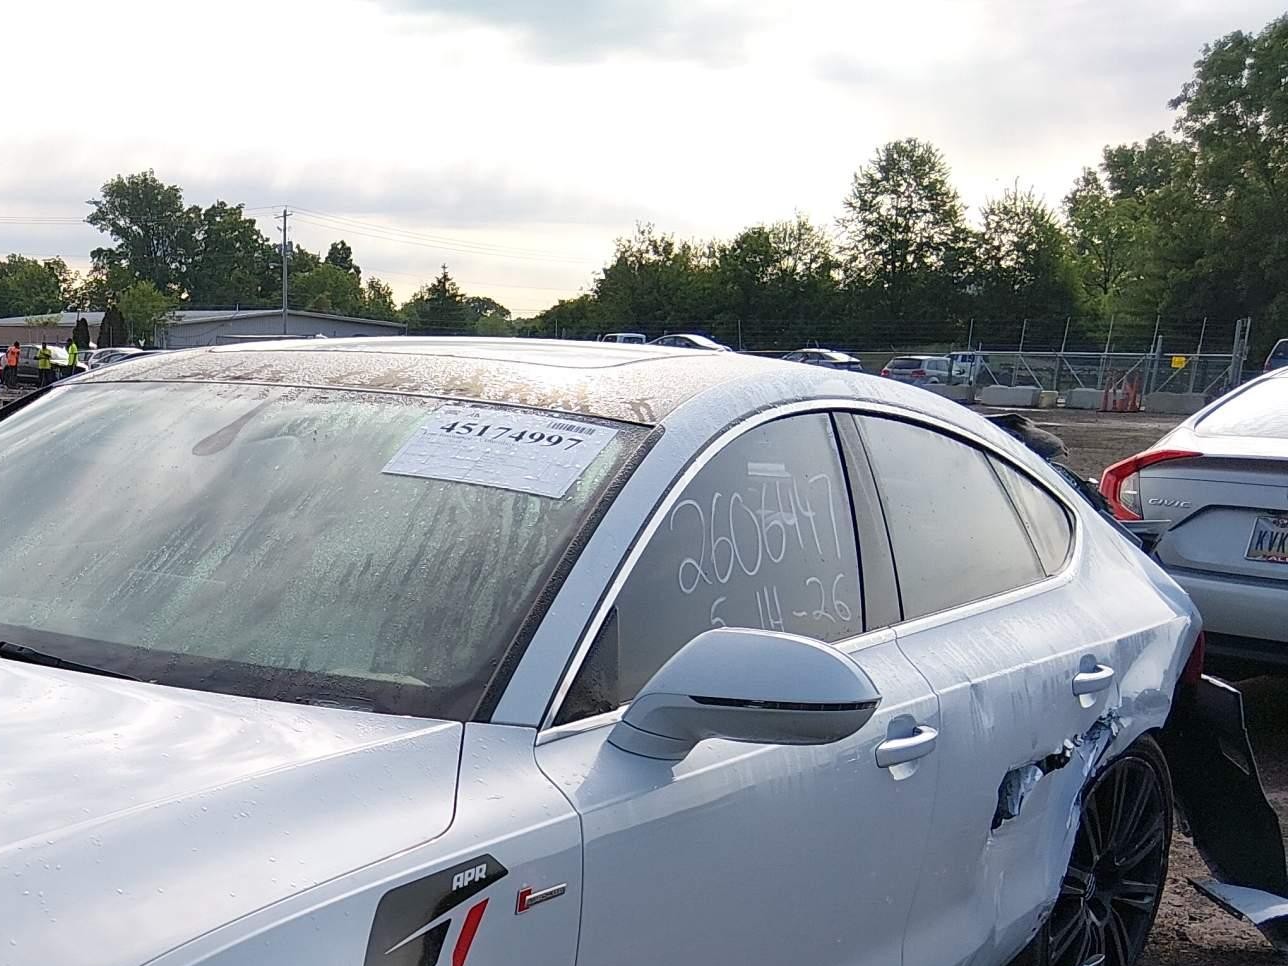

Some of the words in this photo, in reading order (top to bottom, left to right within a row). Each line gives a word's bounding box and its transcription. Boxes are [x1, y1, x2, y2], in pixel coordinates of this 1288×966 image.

[440, 421, 583, 451] 45174997
[1148, 498, 1192, 508] CIVIC
[452, 863, 487, 891] APR
